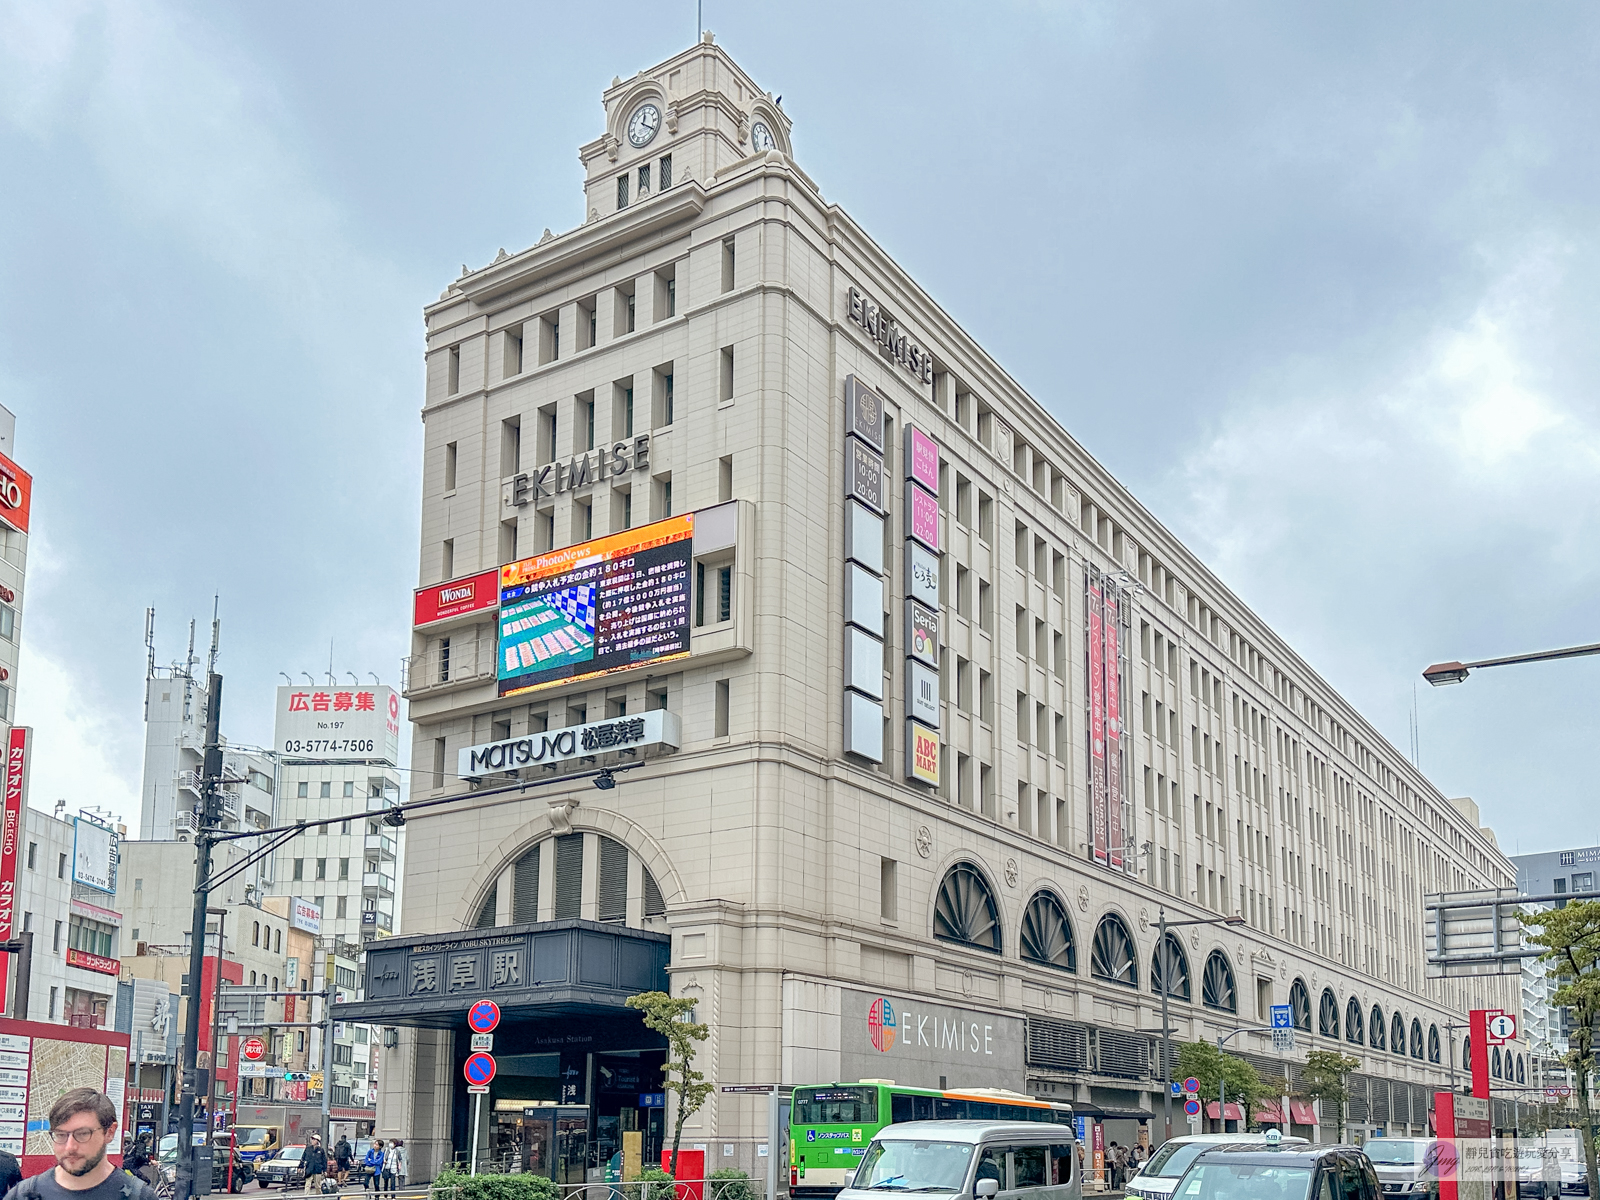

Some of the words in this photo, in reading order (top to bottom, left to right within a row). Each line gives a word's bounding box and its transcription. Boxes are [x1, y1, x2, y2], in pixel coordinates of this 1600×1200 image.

[847, 286, 932, 385] EKIMISE
[855, 416, 882, 442] EKIMISE
[512, 433, 650, 507] EKIMISE
[855, 449, 880, 474] 営業時間
[916, 457, 934, 479] ごはん
[858, 463, 877, 484] 10:00
[857, 481, 877, 503] 20:00
[914, 492, 936, 513] レストラン
[917, 506, 933, 525] 11:00
[916, 523, 933, 543] 22:00
[536, 547, 591, 569] PhotoNews
[1091, 595, 1099, 612] 7F
[914, 609, 936, 633] Seria
[1107, 608, 1115, 624] 7F
[288, 691, 376, 712] 広告募集
[317, 721, 345, 729] No.197
[580, 717, 645, 751] 松屋浅草
[285, 739, 374, 753] 03-5774-7506
[916, 735, 936, 760] ABC
[7, 747, 24, 799] カラオケ
[916, 754, 936, 774] MART
[0, 880, 14, 933] カラオケ
[461, 939, 480, 949] TOBU
[480, 936, 510, 947] SKYTREE
[510, 935, 524, 944] Line
[86, 955, 112, 970] サンドラッグ
[410, 951, 519, 993] 浅草駅
[535, 1036, 564, 1044] Asakusa
[566, 1034, 593, 1043] Station
[902, 1011, 993, 1055] EKIMISE
